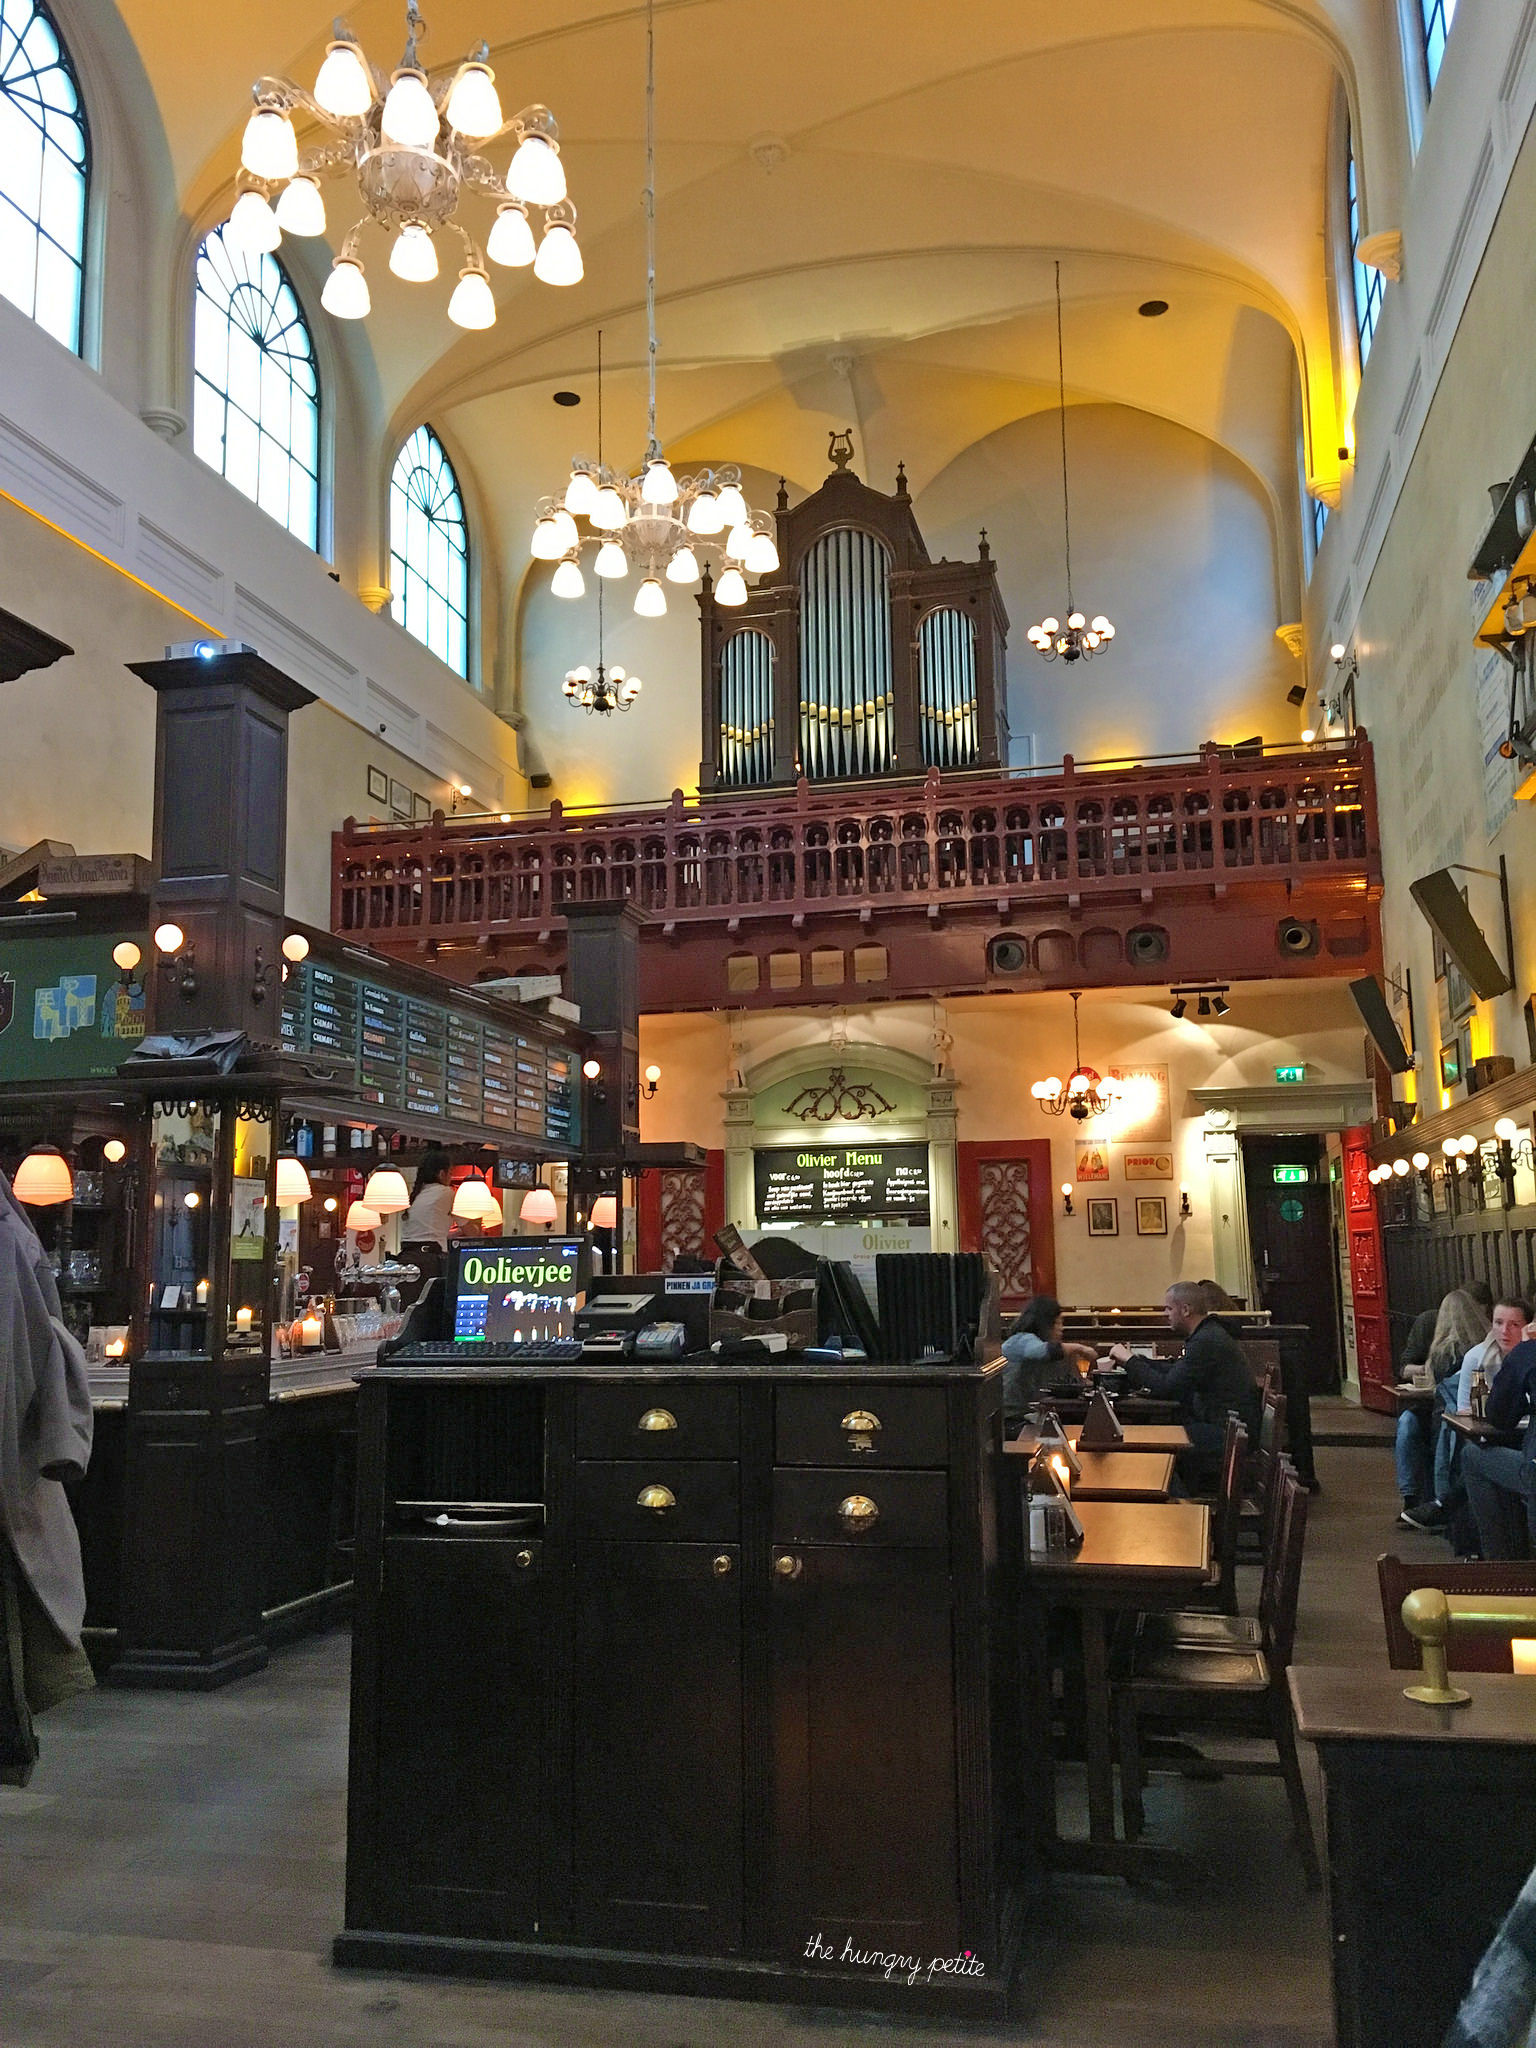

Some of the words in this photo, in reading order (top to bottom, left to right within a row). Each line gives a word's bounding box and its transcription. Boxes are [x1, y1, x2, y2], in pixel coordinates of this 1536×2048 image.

[797, 1154, 837, 1168] Olivier
[845, 1151, 883, 1166] Menu
[1127, 1158, 1155, 1166] PRIOR
[823, 1167, 850, 1179] hoofd
[896, 1167, 908, 1176] na
[862, 1233, 913, 1250] Olivier
[464, 1257, 572, 1288] Oolievjee
[666, 1281, 691, 1290] PINNEN
[691, 1281, 702, 1290] JA
